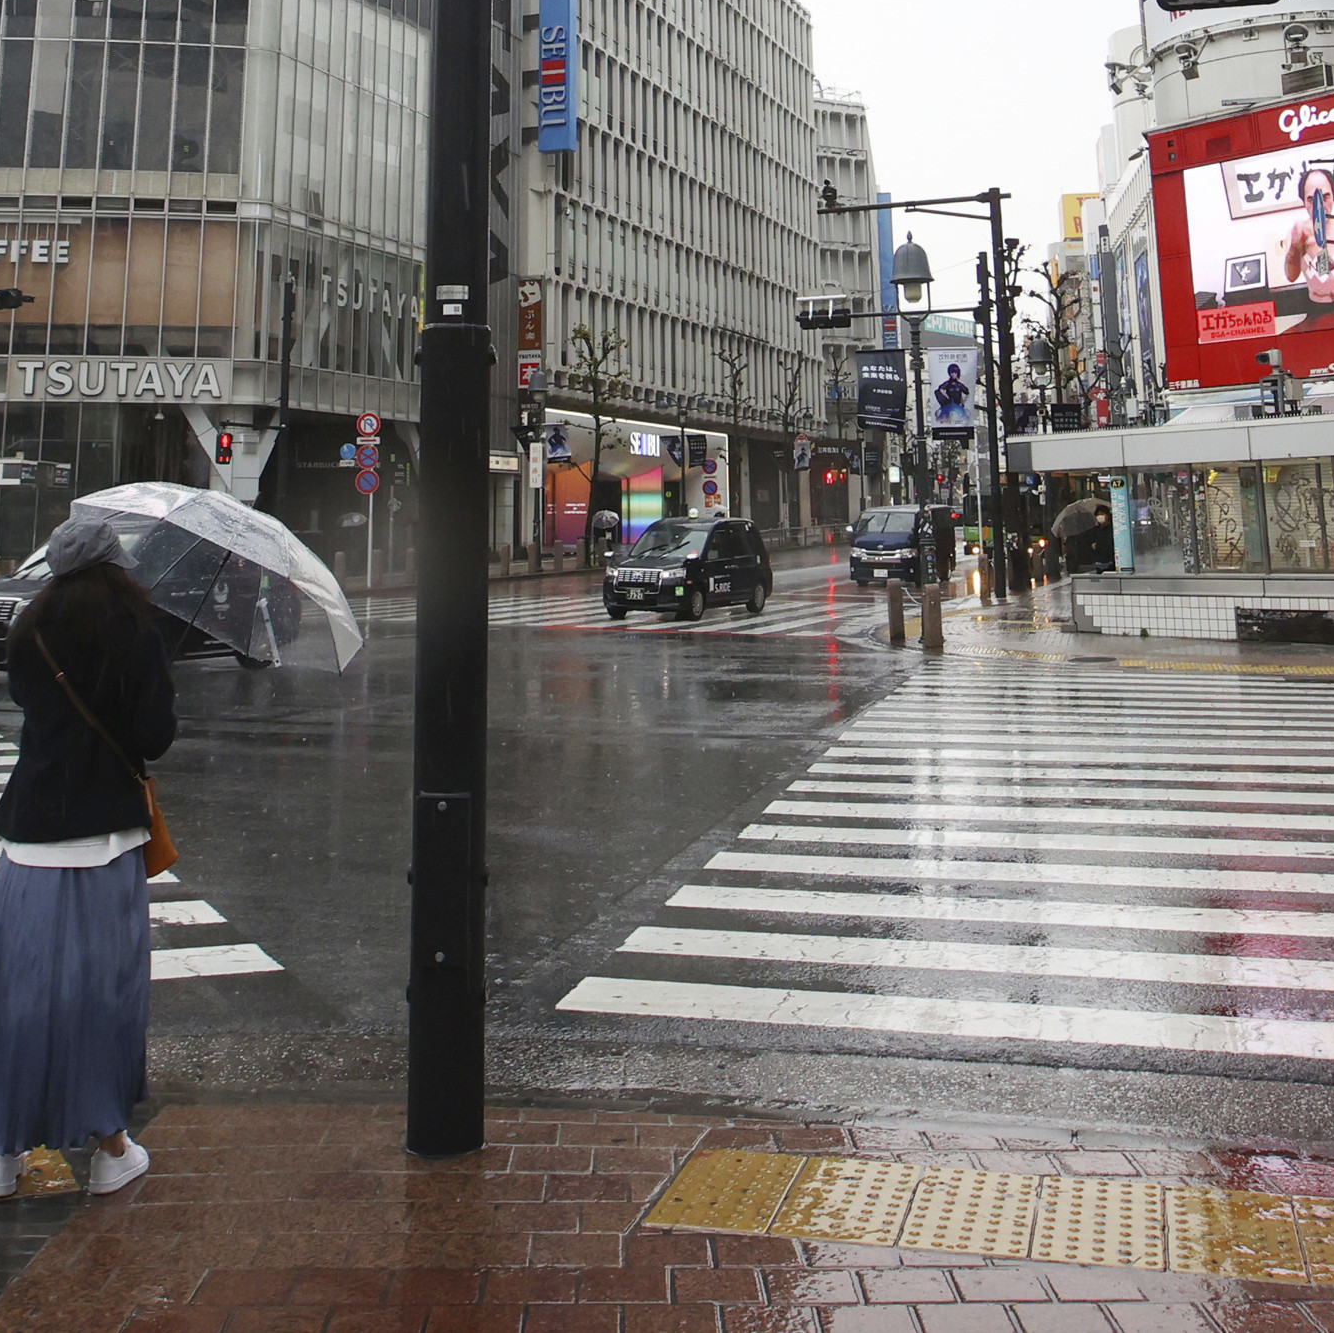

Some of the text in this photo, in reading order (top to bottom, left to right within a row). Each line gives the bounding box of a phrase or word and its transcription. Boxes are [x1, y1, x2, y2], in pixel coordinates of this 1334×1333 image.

[321, 273, 419, 323] TSUTAYA
[1201, 311, 1272, 331] エガちゃんねる
[17, 360, 222, 397] TSUTAYA
